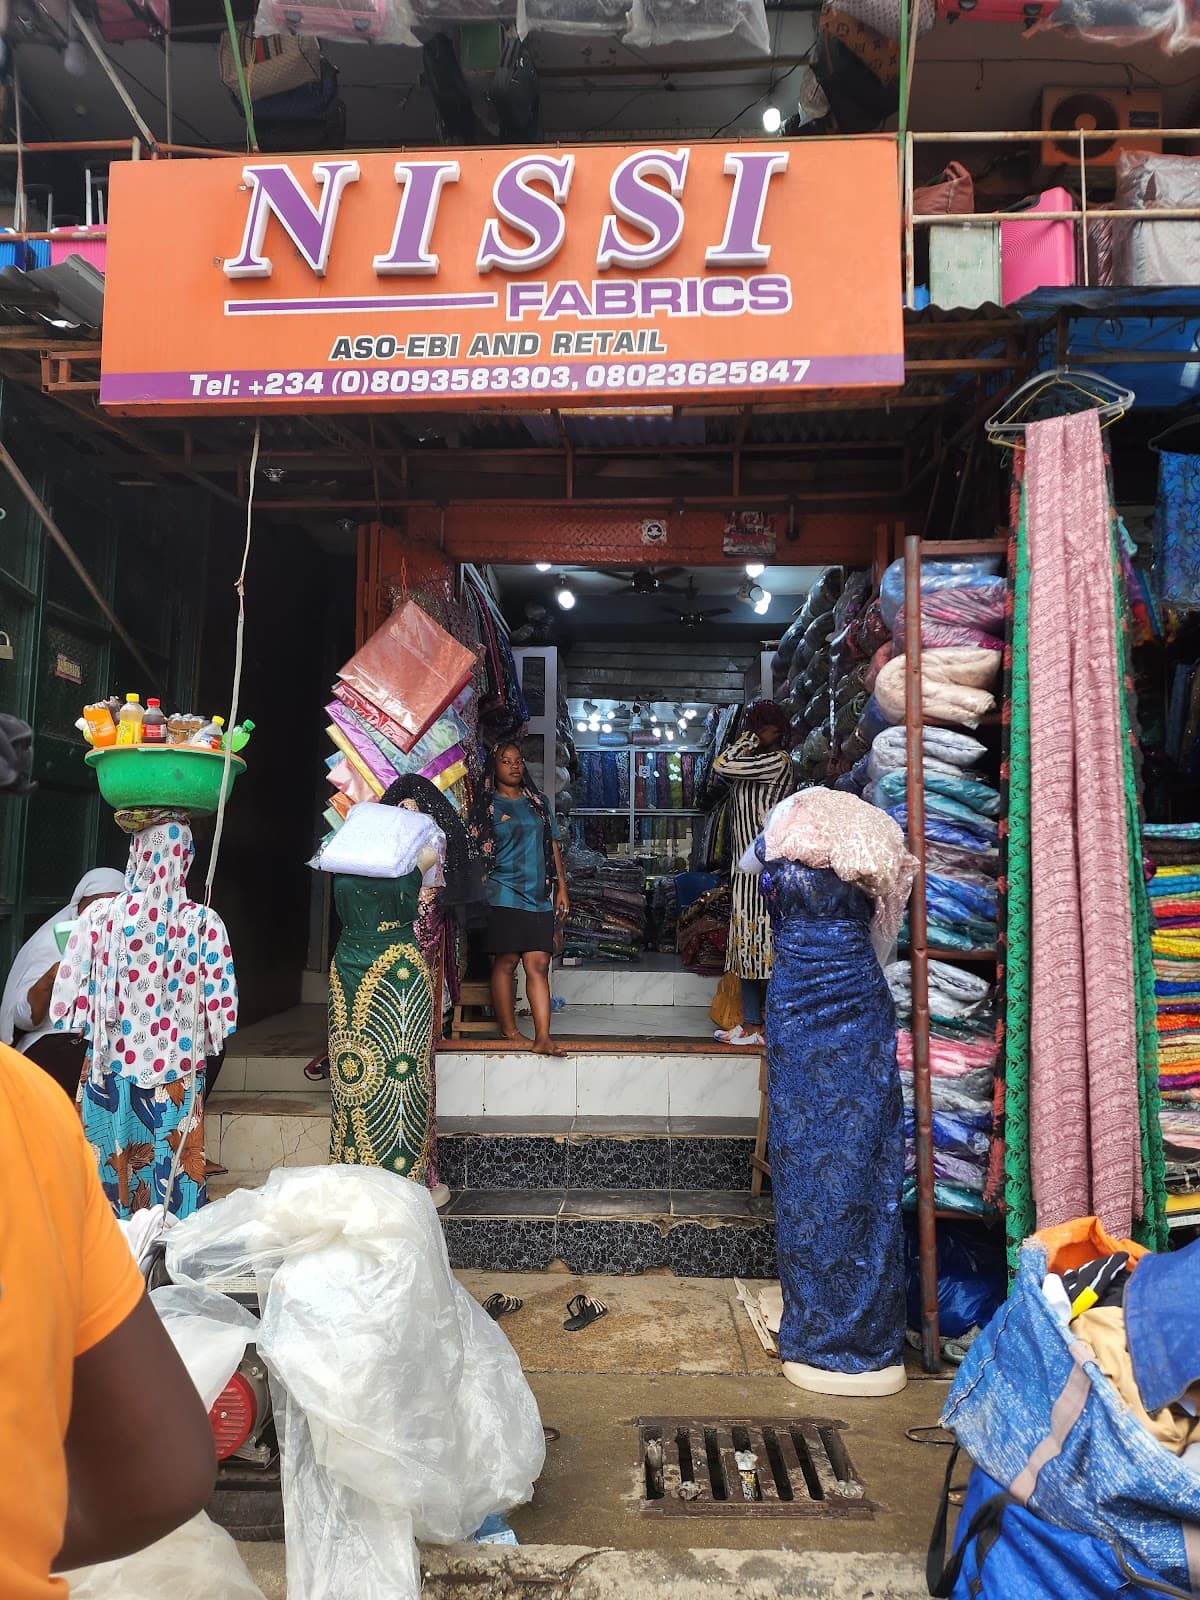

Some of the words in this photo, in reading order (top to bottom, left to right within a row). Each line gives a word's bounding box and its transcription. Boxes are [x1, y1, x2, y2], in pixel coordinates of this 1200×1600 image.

[223, 148, 789, 278] NISSI
[507, 275, 791, 320] FABRICS
[329, 334, 461, 361] ASO-EBI
[467, 332, 540, 358] AND
[551, 329, 667, 355] RETAIL
[190, 374, 240, 396] Tel:
[248, 371, 324, 396] +234
[331, 365, 579, 395] (0)8093583303,
[586, 360, 810, 388] 08023625847
